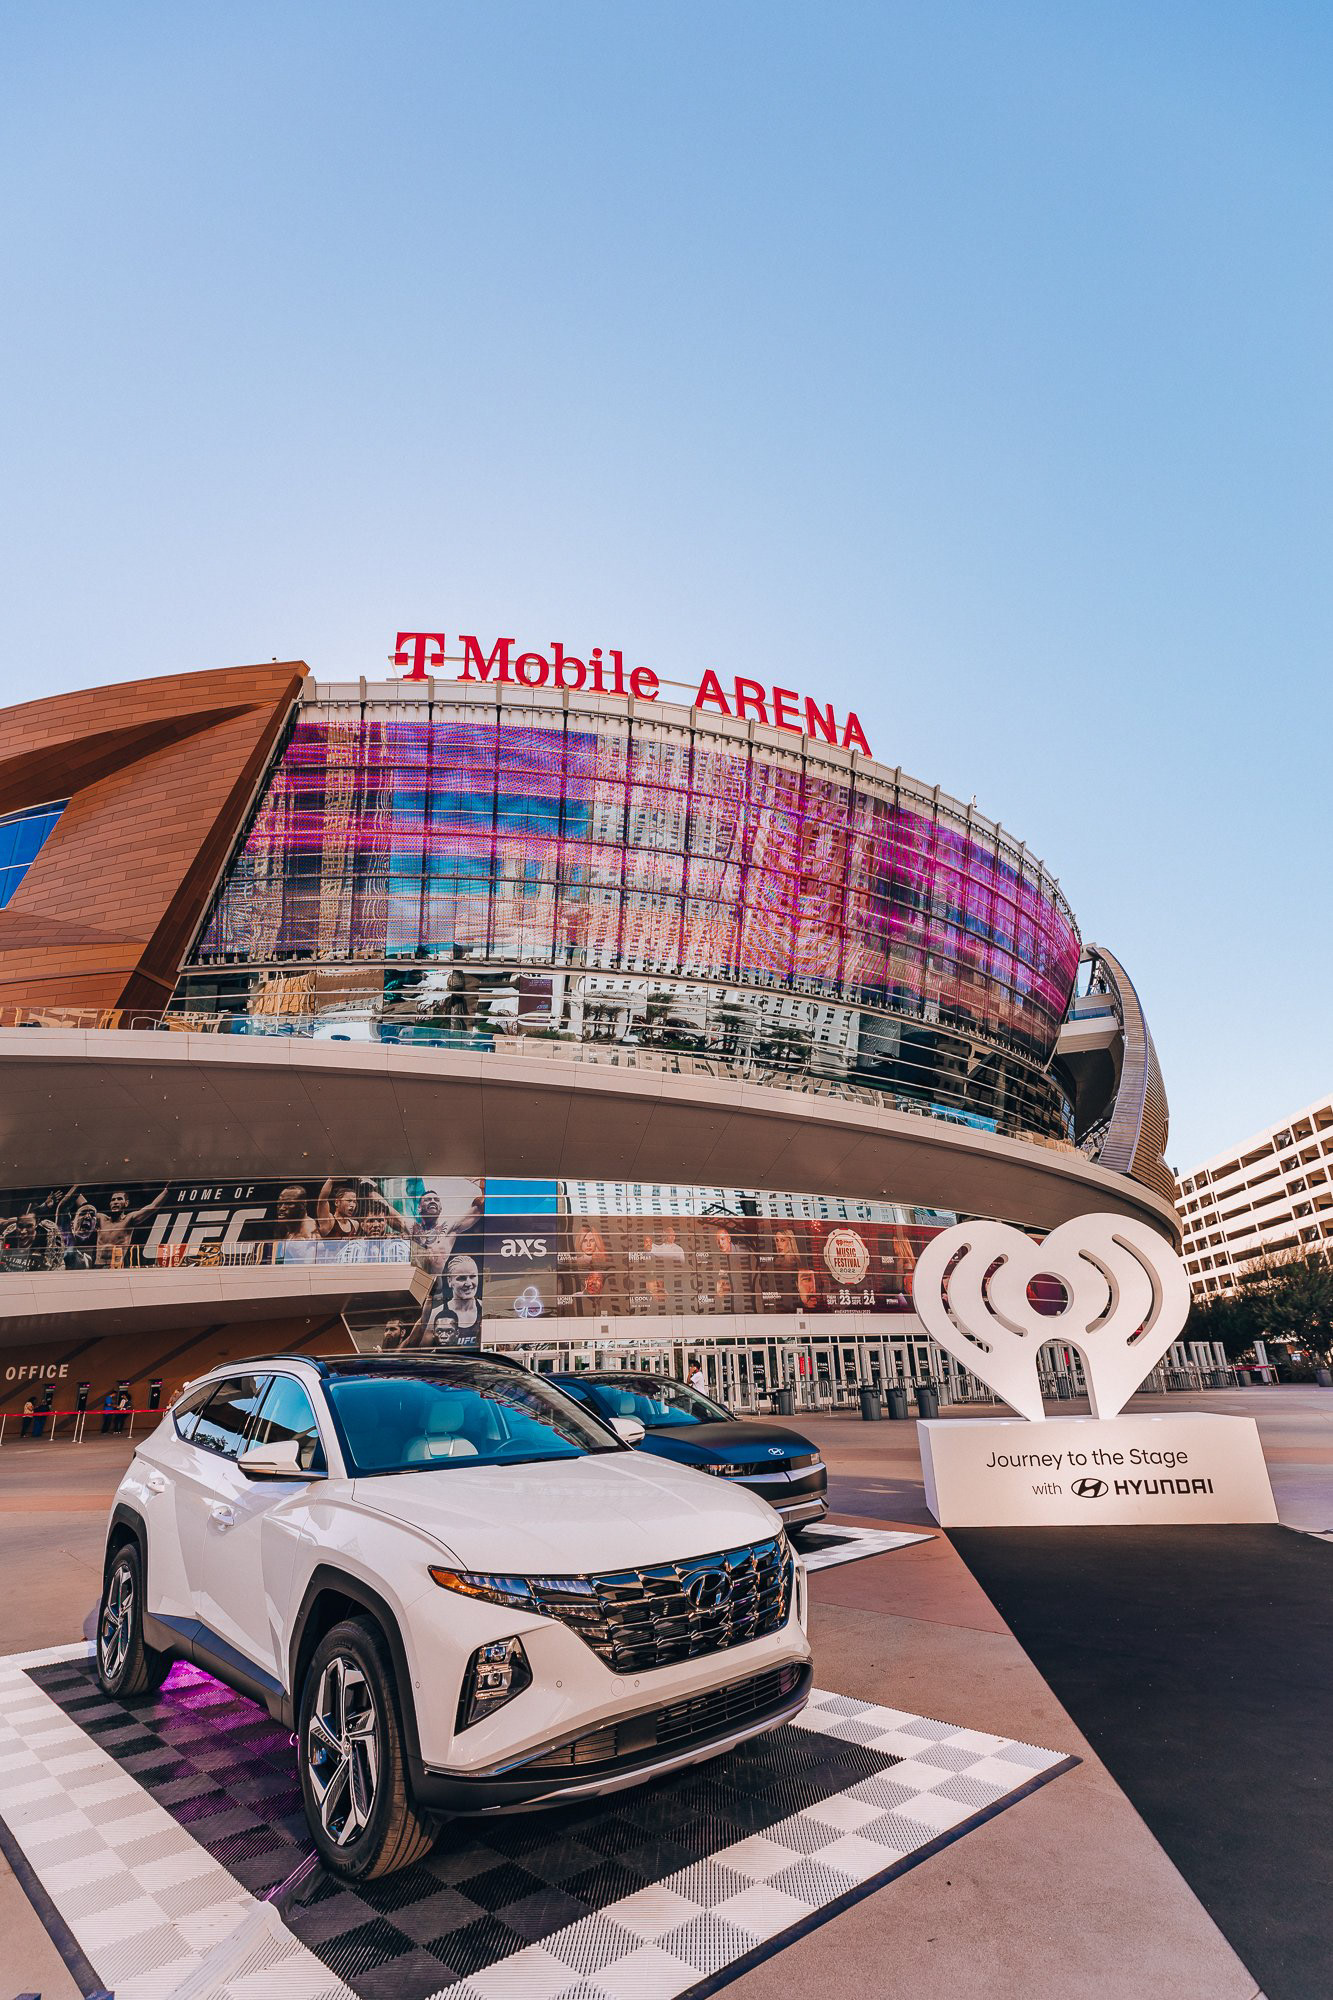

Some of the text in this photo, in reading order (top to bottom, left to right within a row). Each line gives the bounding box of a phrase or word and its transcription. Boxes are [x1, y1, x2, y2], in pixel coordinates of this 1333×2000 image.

[457, 635, 660, 702] Mobile
[695, 669, 873, 759] ARENA
[177, 1186, 254, 1202] HOME OF
[142, 1208, 267, 1259] UFC
[836, 1247, 856, 1257] MUSIC
[834, 1257, 860, 1268] FESTIVAL
[840, 1294, 851, 1305] 23
[863, 1294, 876, 1305] 24
[457, 1336, 477, 1345] UFC
[5, 1364, 69, 1381] OFFICE
[986, 1448, 1188, 1470] Journey to the Stage
[1031, 1478, 1214, 1495] with HYUNDAI
